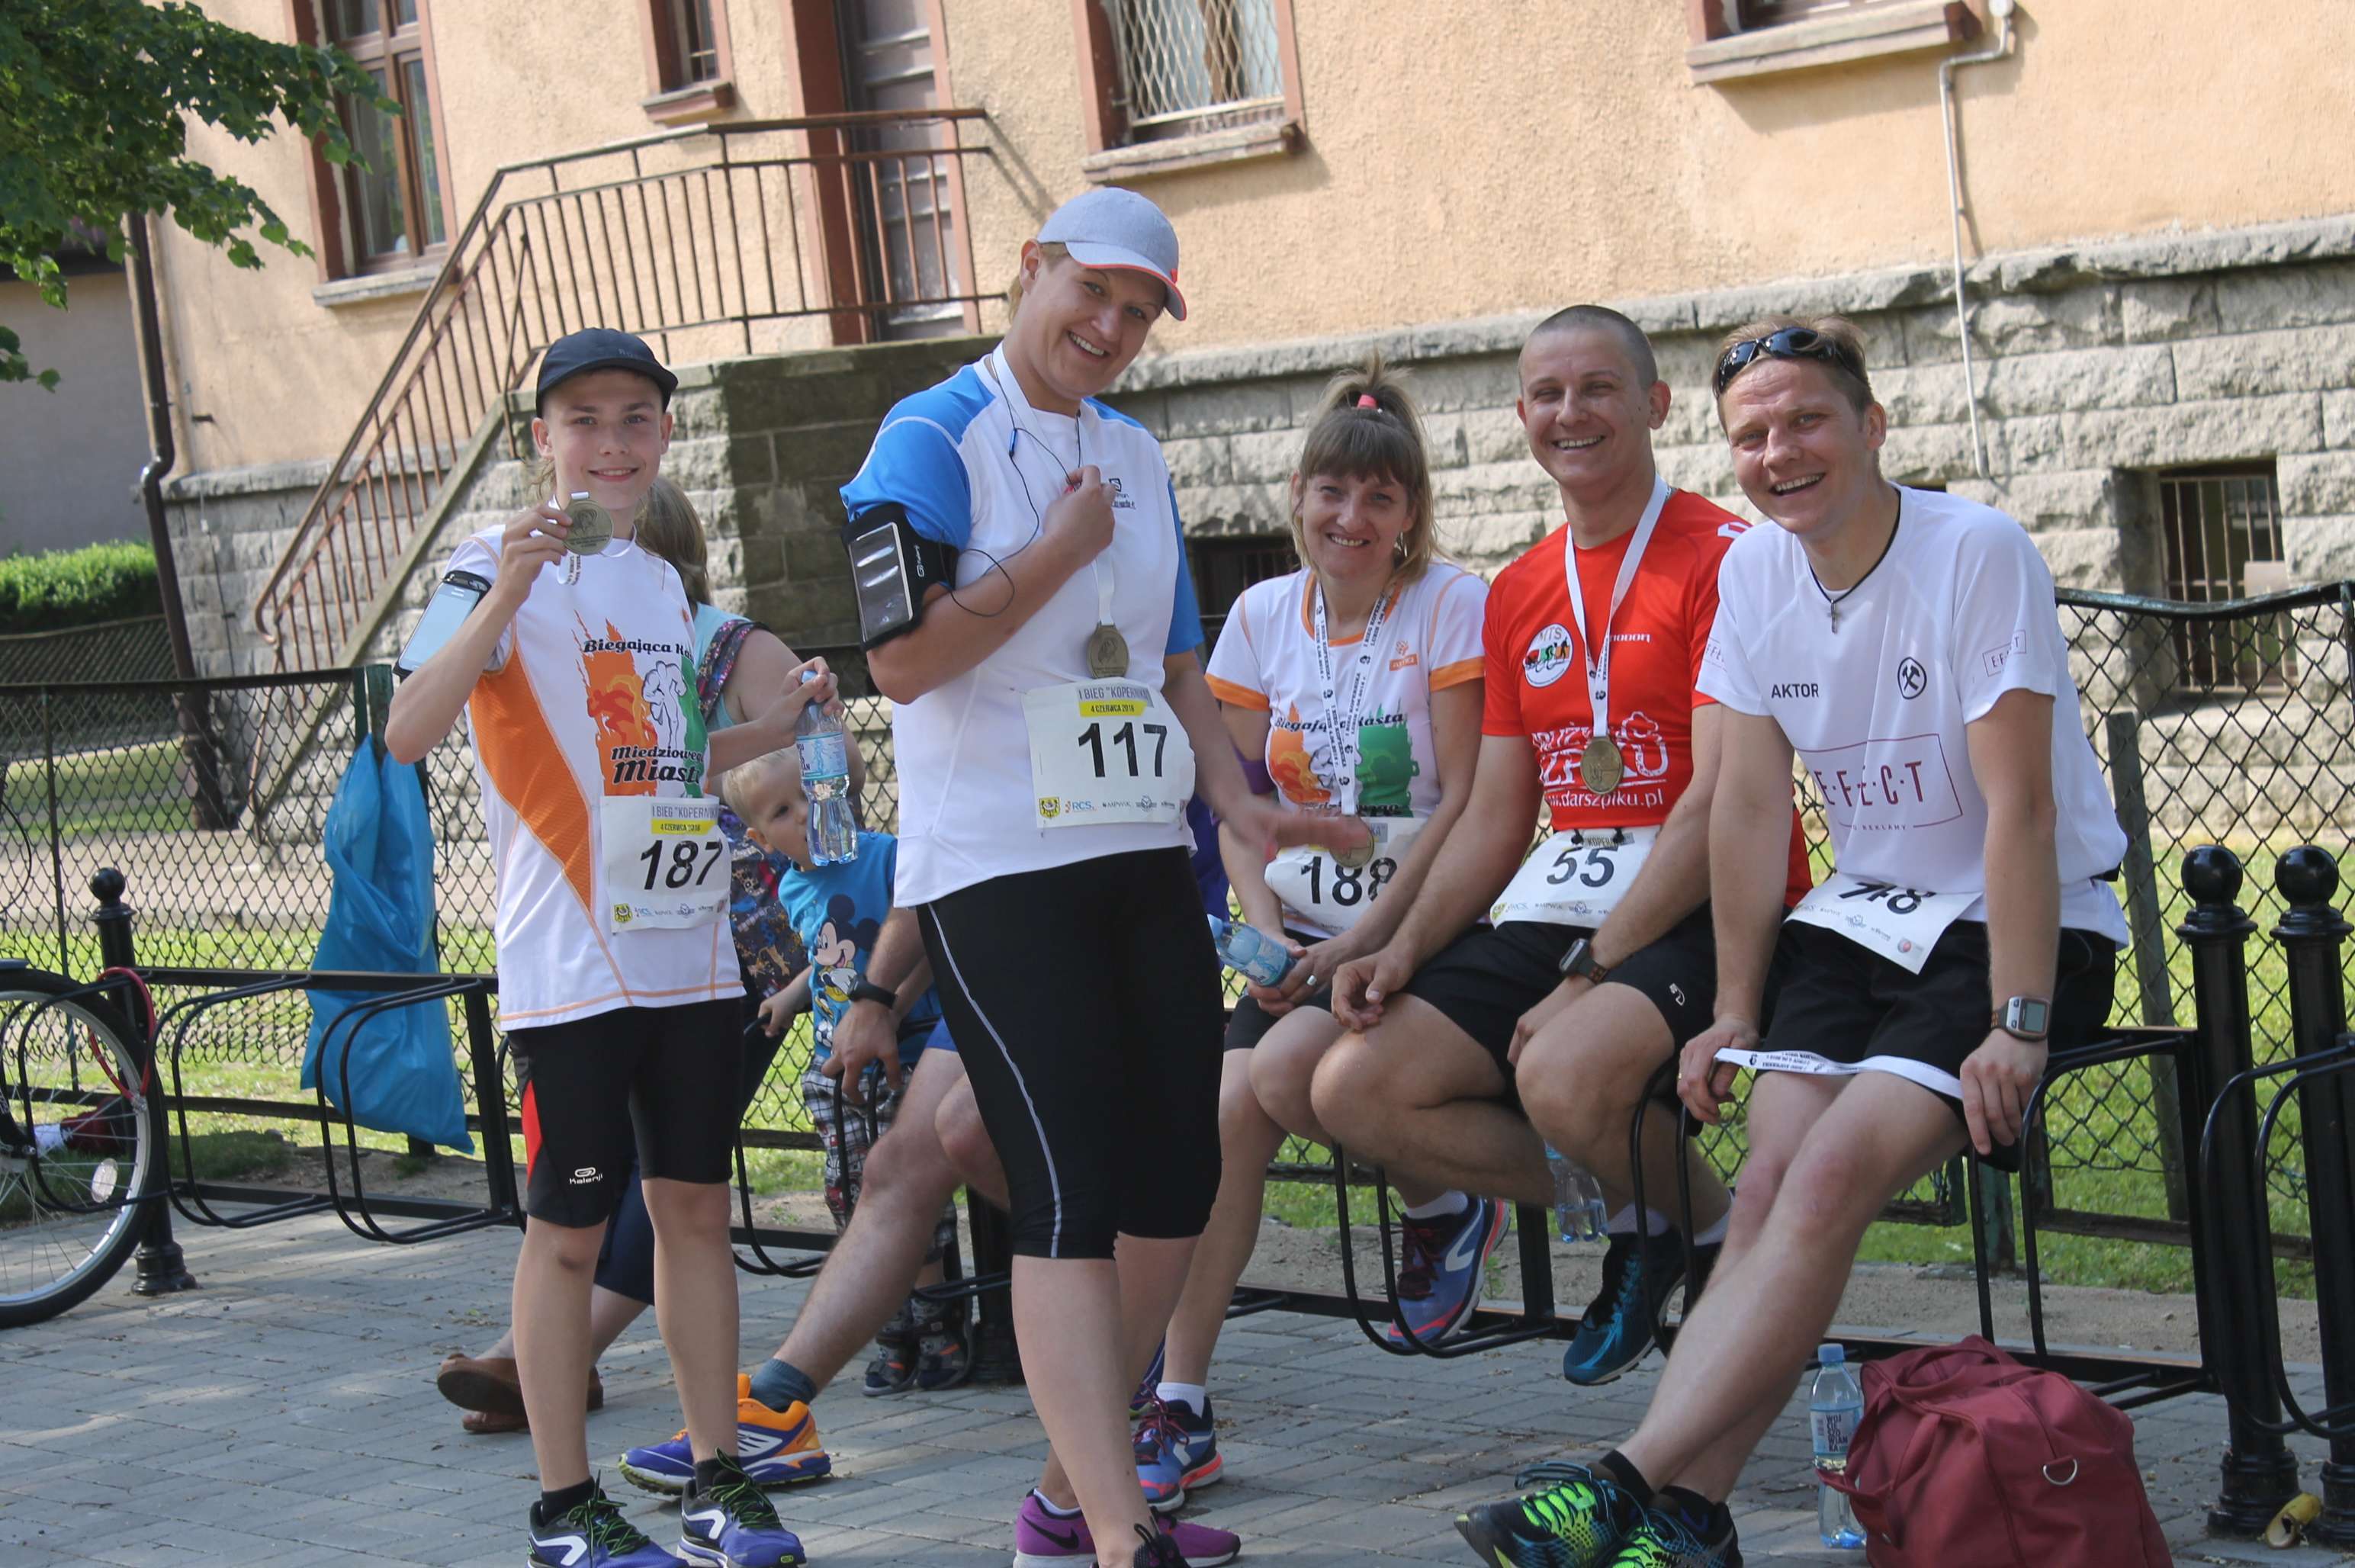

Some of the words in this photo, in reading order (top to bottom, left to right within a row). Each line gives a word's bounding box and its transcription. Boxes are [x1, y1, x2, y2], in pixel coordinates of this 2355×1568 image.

[583, 639, 672, 655] Biegająca
[1084, 687, 1104, 700] BIEG
[1771, 683, 1819, 699] AKTOR
[1078, 721, 1168, 778] 117
[613, 759, 701, 784] Miast
[657, 805, 673, 818] BIEG
[641, 839, 723, 890] 187
[1547, 846, 1618, 888] 55
[1301, 856, 1398, 907] 188
